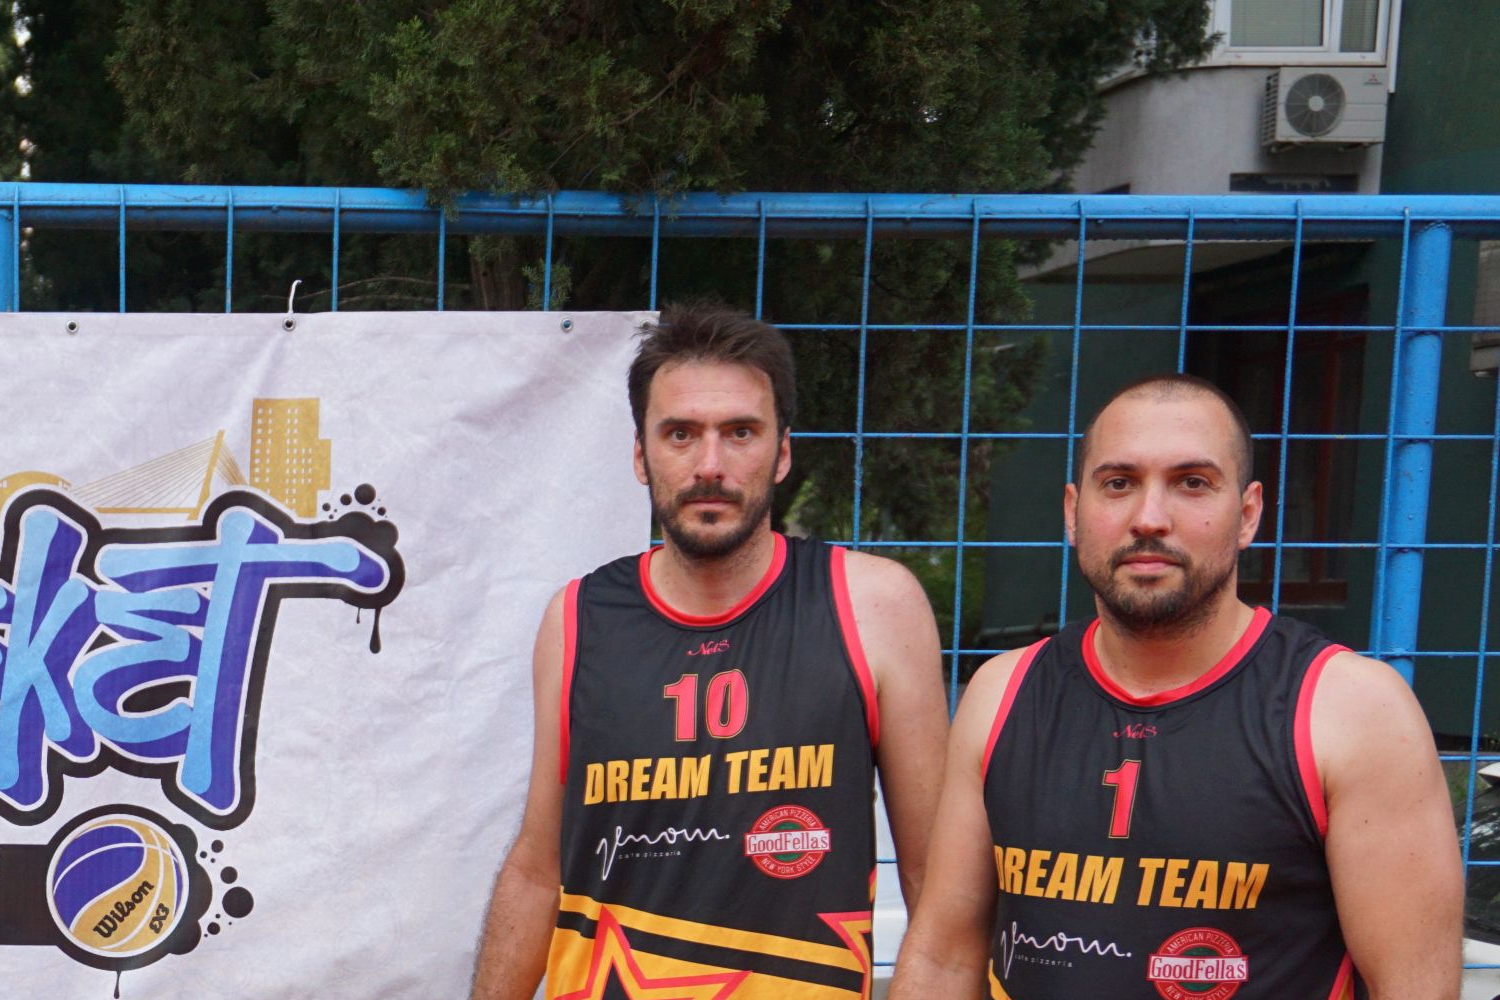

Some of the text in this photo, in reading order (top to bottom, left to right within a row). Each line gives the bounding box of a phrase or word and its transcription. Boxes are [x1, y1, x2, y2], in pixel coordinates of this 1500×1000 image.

[663, 669, 749, 742] 10
[583, 743, 835, 806] DREAM TEAM
[1102, 758, 1142, 839] 1
[759, 809, 789, 831] AMERICAN
[761, 855, 817, 874] NEW YORK STYLE
[1136, 857, 1271, 910] TEAM
[92, 880, 155, 938] Wilson
[1166, 932, 1235, 954] AMERICAN PIZZERIA
[1164, 985, 1182, 1000] NEW
